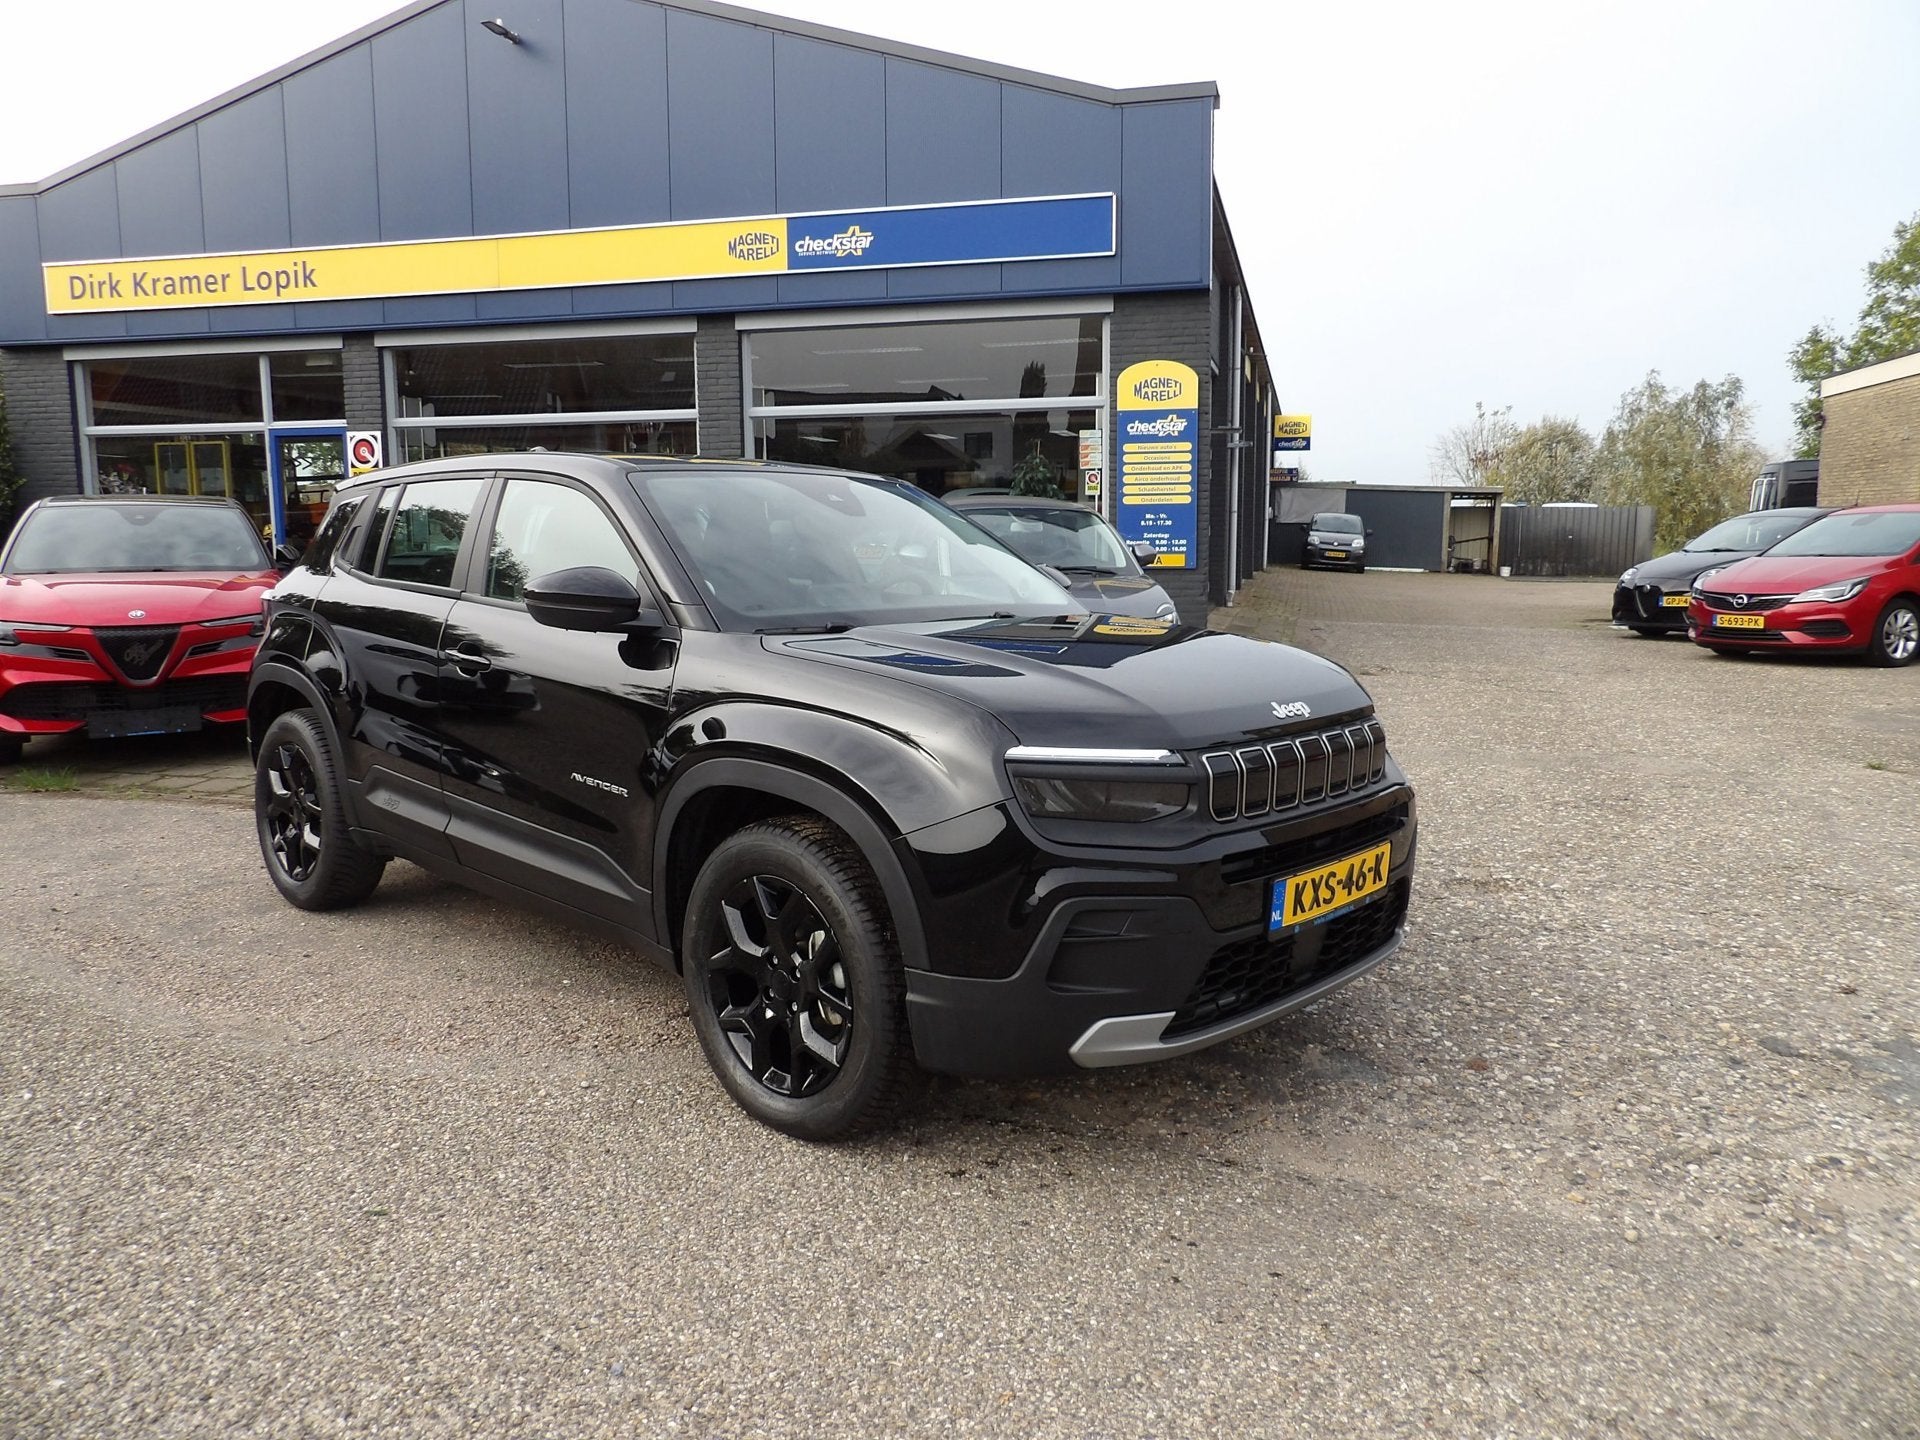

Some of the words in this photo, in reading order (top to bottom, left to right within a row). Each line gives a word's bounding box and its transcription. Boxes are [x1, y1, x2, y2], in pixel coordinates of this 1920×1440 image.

[728, 232, 779, 257] MAGNETI
[728, 238, 779, 261] MARELLI
[795, 234, 874, 253] checkstar
[69, 272, 123, 300] Dirk
[133, 271, 231, 296] Kramer
[242, 260, 317, 296] Lopik
[1134, 377, 1182, 397] MAGNETI
[1134, 383, 1182, 402] MARELLI
[1126, 420, 1188, 433] checkstar
[1665, 597, 1688, 605] GPJ-4
[1719, 616, 1760, 627] S-693-PK
[1270, 701, 1311, 719] Jeep
[570, 772, 628, 797] AVENGER
[1271, 910, 1282, 922] NL
[1292, 851, 1385, 917] KXS-46-K
